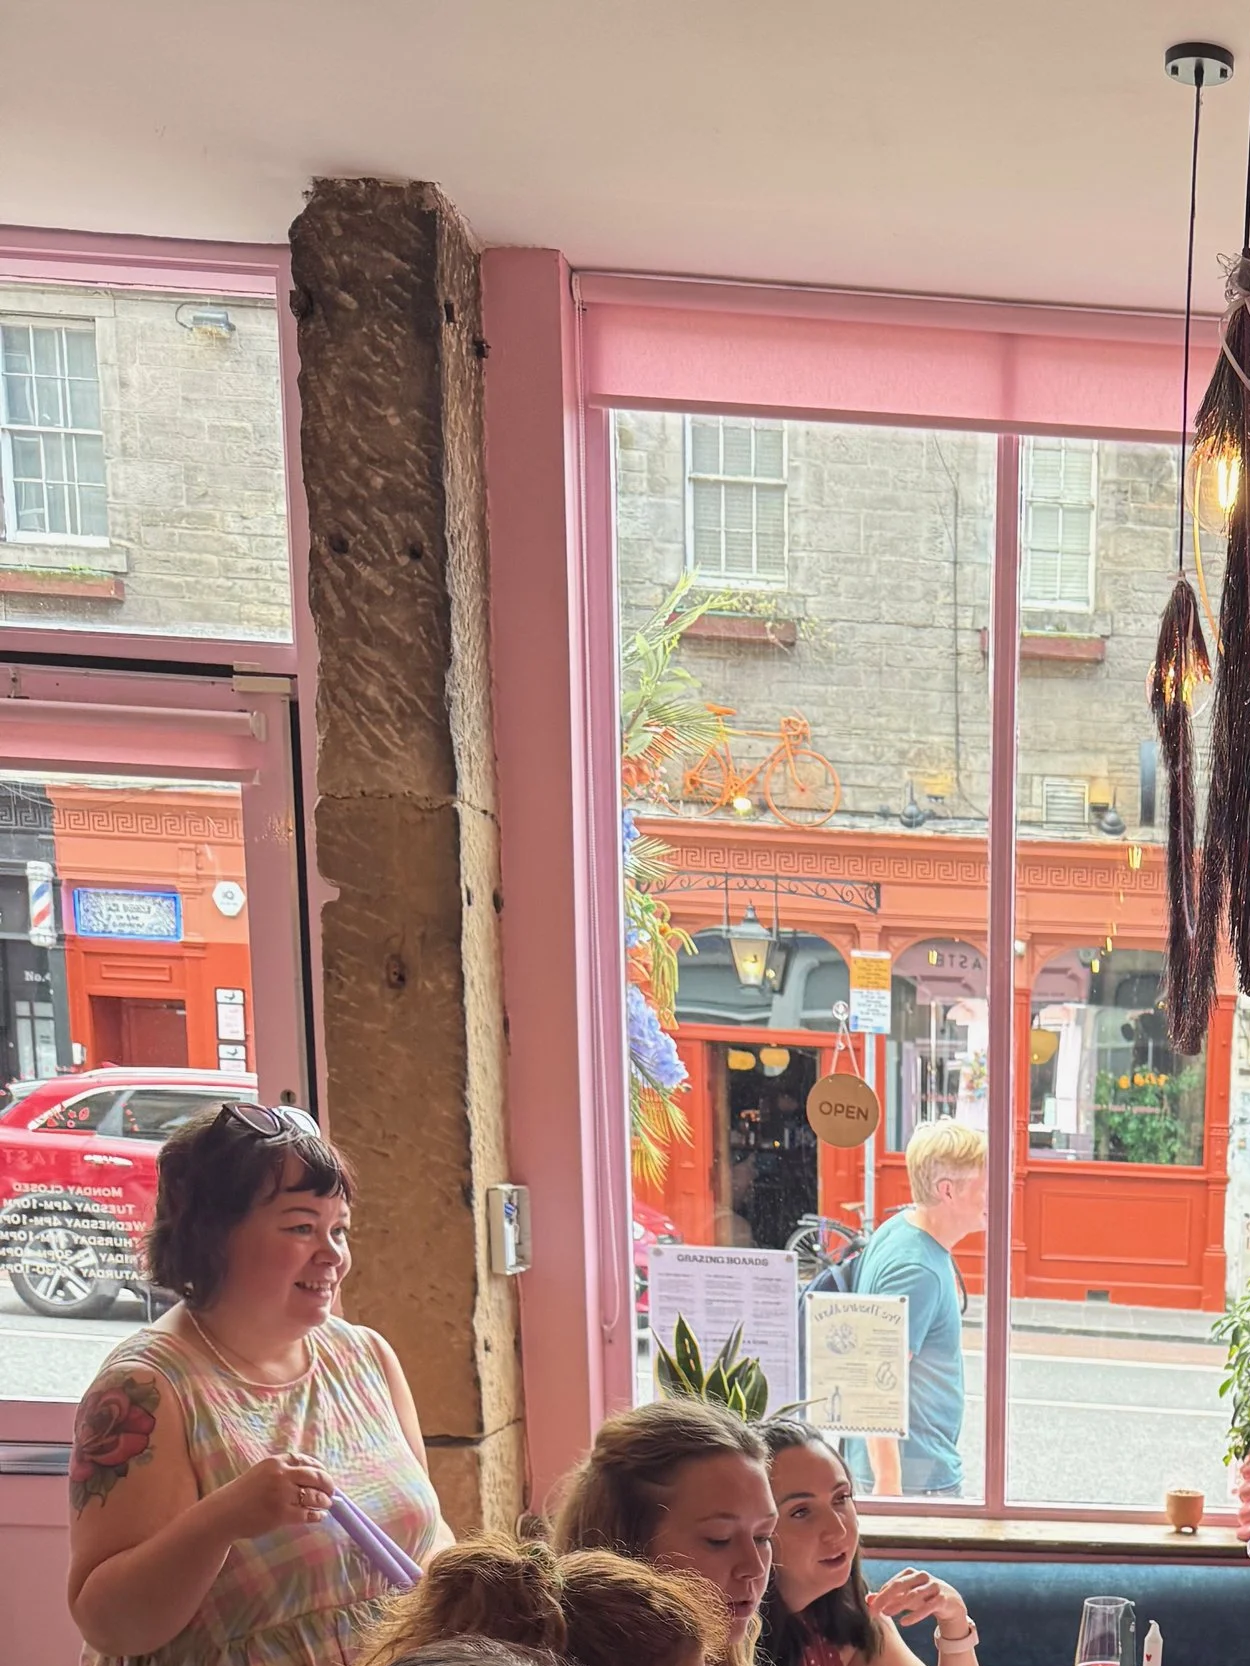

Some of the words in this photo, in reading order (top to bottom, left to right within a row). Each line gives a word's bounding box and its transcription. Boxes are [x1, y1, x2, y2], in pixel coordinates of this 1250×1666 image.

[819, 1101, 868, 1121] OPEN
[677, 1253, 725, 1265] GRAZING
[726, 1256, 769, 1267] BOARDS
